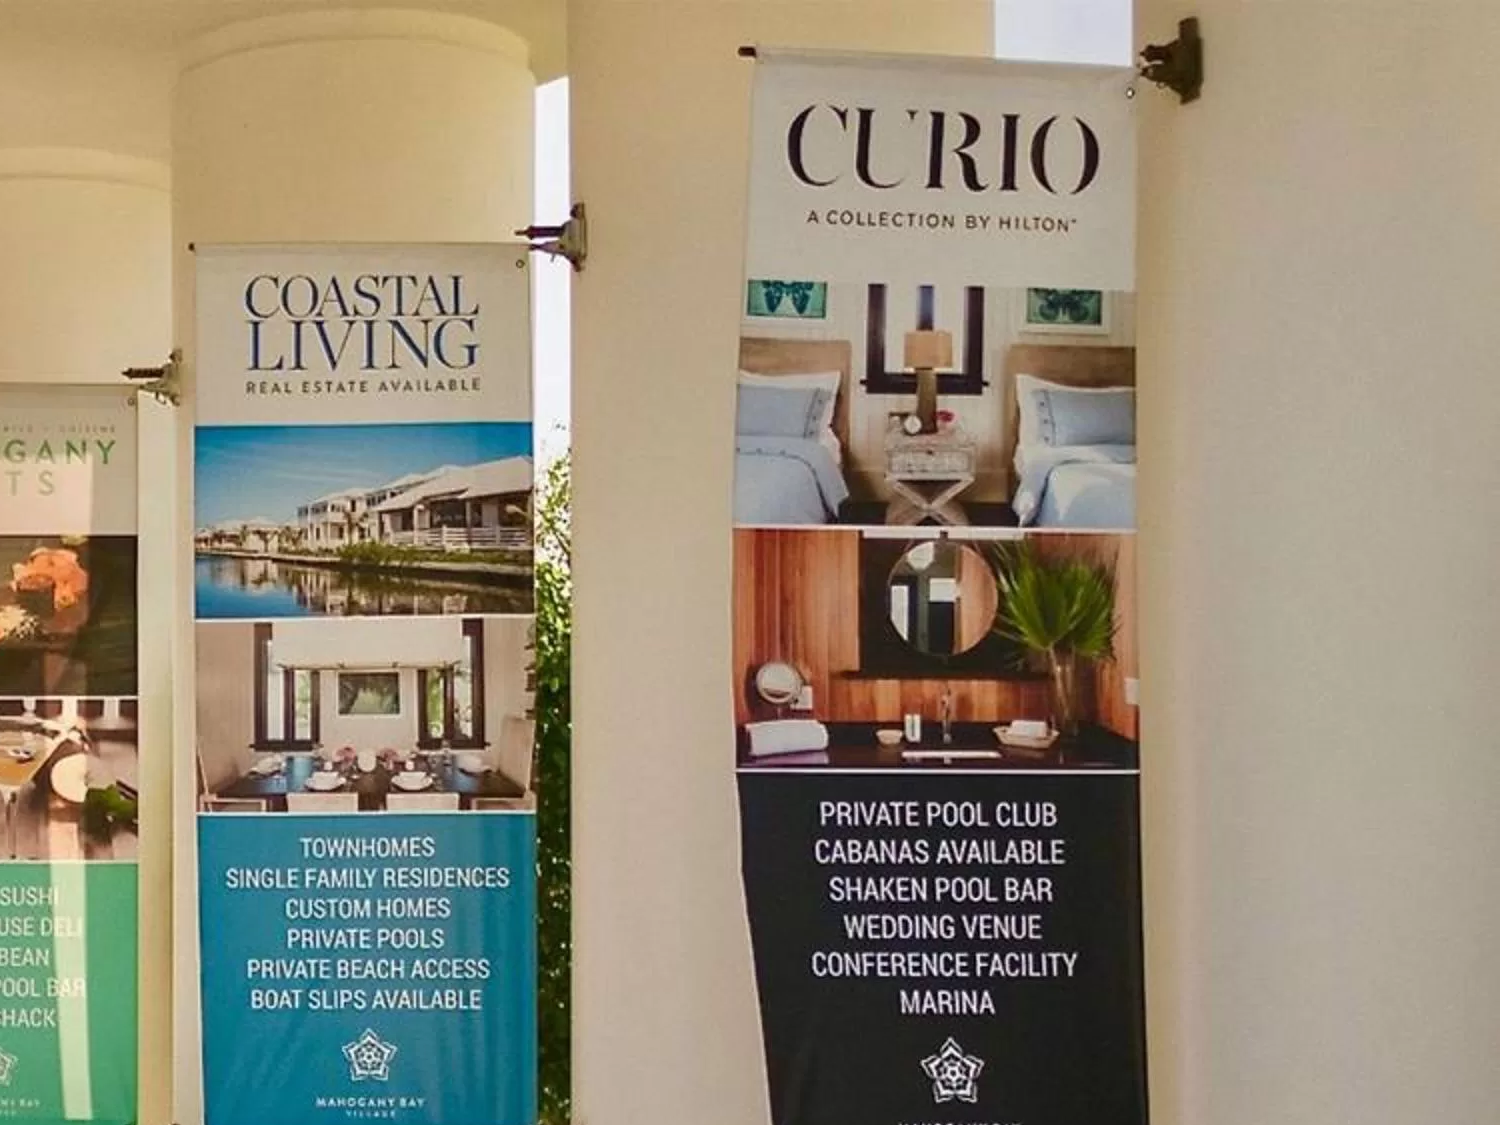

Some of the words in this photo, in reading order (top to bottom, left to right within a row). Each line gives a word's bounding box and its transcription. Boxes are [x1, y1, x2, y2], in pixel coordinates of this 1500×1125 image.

[787, 104, 1100, 195] CURIO
[807, 210, 819, 224] A
[826, 210, 955, 229] COLLECTION
[965, 215, 991, 230] BY
[245, 275, 479, 319] COASTAL
[246, 318, 480, 372] LIVING
[246, 381, 293, 395] REAL
[301, 380, 368, 394] ESTATE
[378, 378, 481, 393] AVAILABLE
[820, 801, 919, 828] PRIVATE
[926, 801, 990, 828] POOL
[995, 801, 1058, 828] CLUB
[300, 837, 436, 857] TOWNHOMES
[814, 839, 929, 865] CABANAS
[936, 839, 1066, 865] AVAILABLE
[226, 868, 299, 888] SINGLE
[304, 868, 378, 888] FAMILY
[383, 867, 510, 887] RESIDENCES
[0, 886, 60, 907] SUSHI
[828, 877, 927, 902] SHAKEN
[934, 877, 998, 902] POOL
[1004, 877, 1053, 902] BAR
[285, 898, 371, 919] CUSTOM
[376, 897, 451, 918] HOMES
[40, 916, 84, 937] DELI
[844, 914, 955, 940] WEDDING
[962, 914, 1042, 940] VENUE
[287, 929, 372, 949] PRIVATE
[377, 929, 445, 949] POOLS
[247, 959, 332, 979] PRIVATE
[337, 959, 405, 979] BEACH
[410, 959, 491, 979] ACCESS
[811, 952, 970, 977] CONFERENCE
[976, 952, 1079, 977] FACILITY
[47, 977, 87, 997] BAR
[251, 989, 302, 1010] BOAT
[308, 989, 367, 1010] SLIPS
[372, 989, 483, 1010] AVAILABLE
[900, 990, 996, 1015] MARINA
[316, 1096, 395, 1108] MAHOGANY
[399, 1096, 425, 1108] BAY
